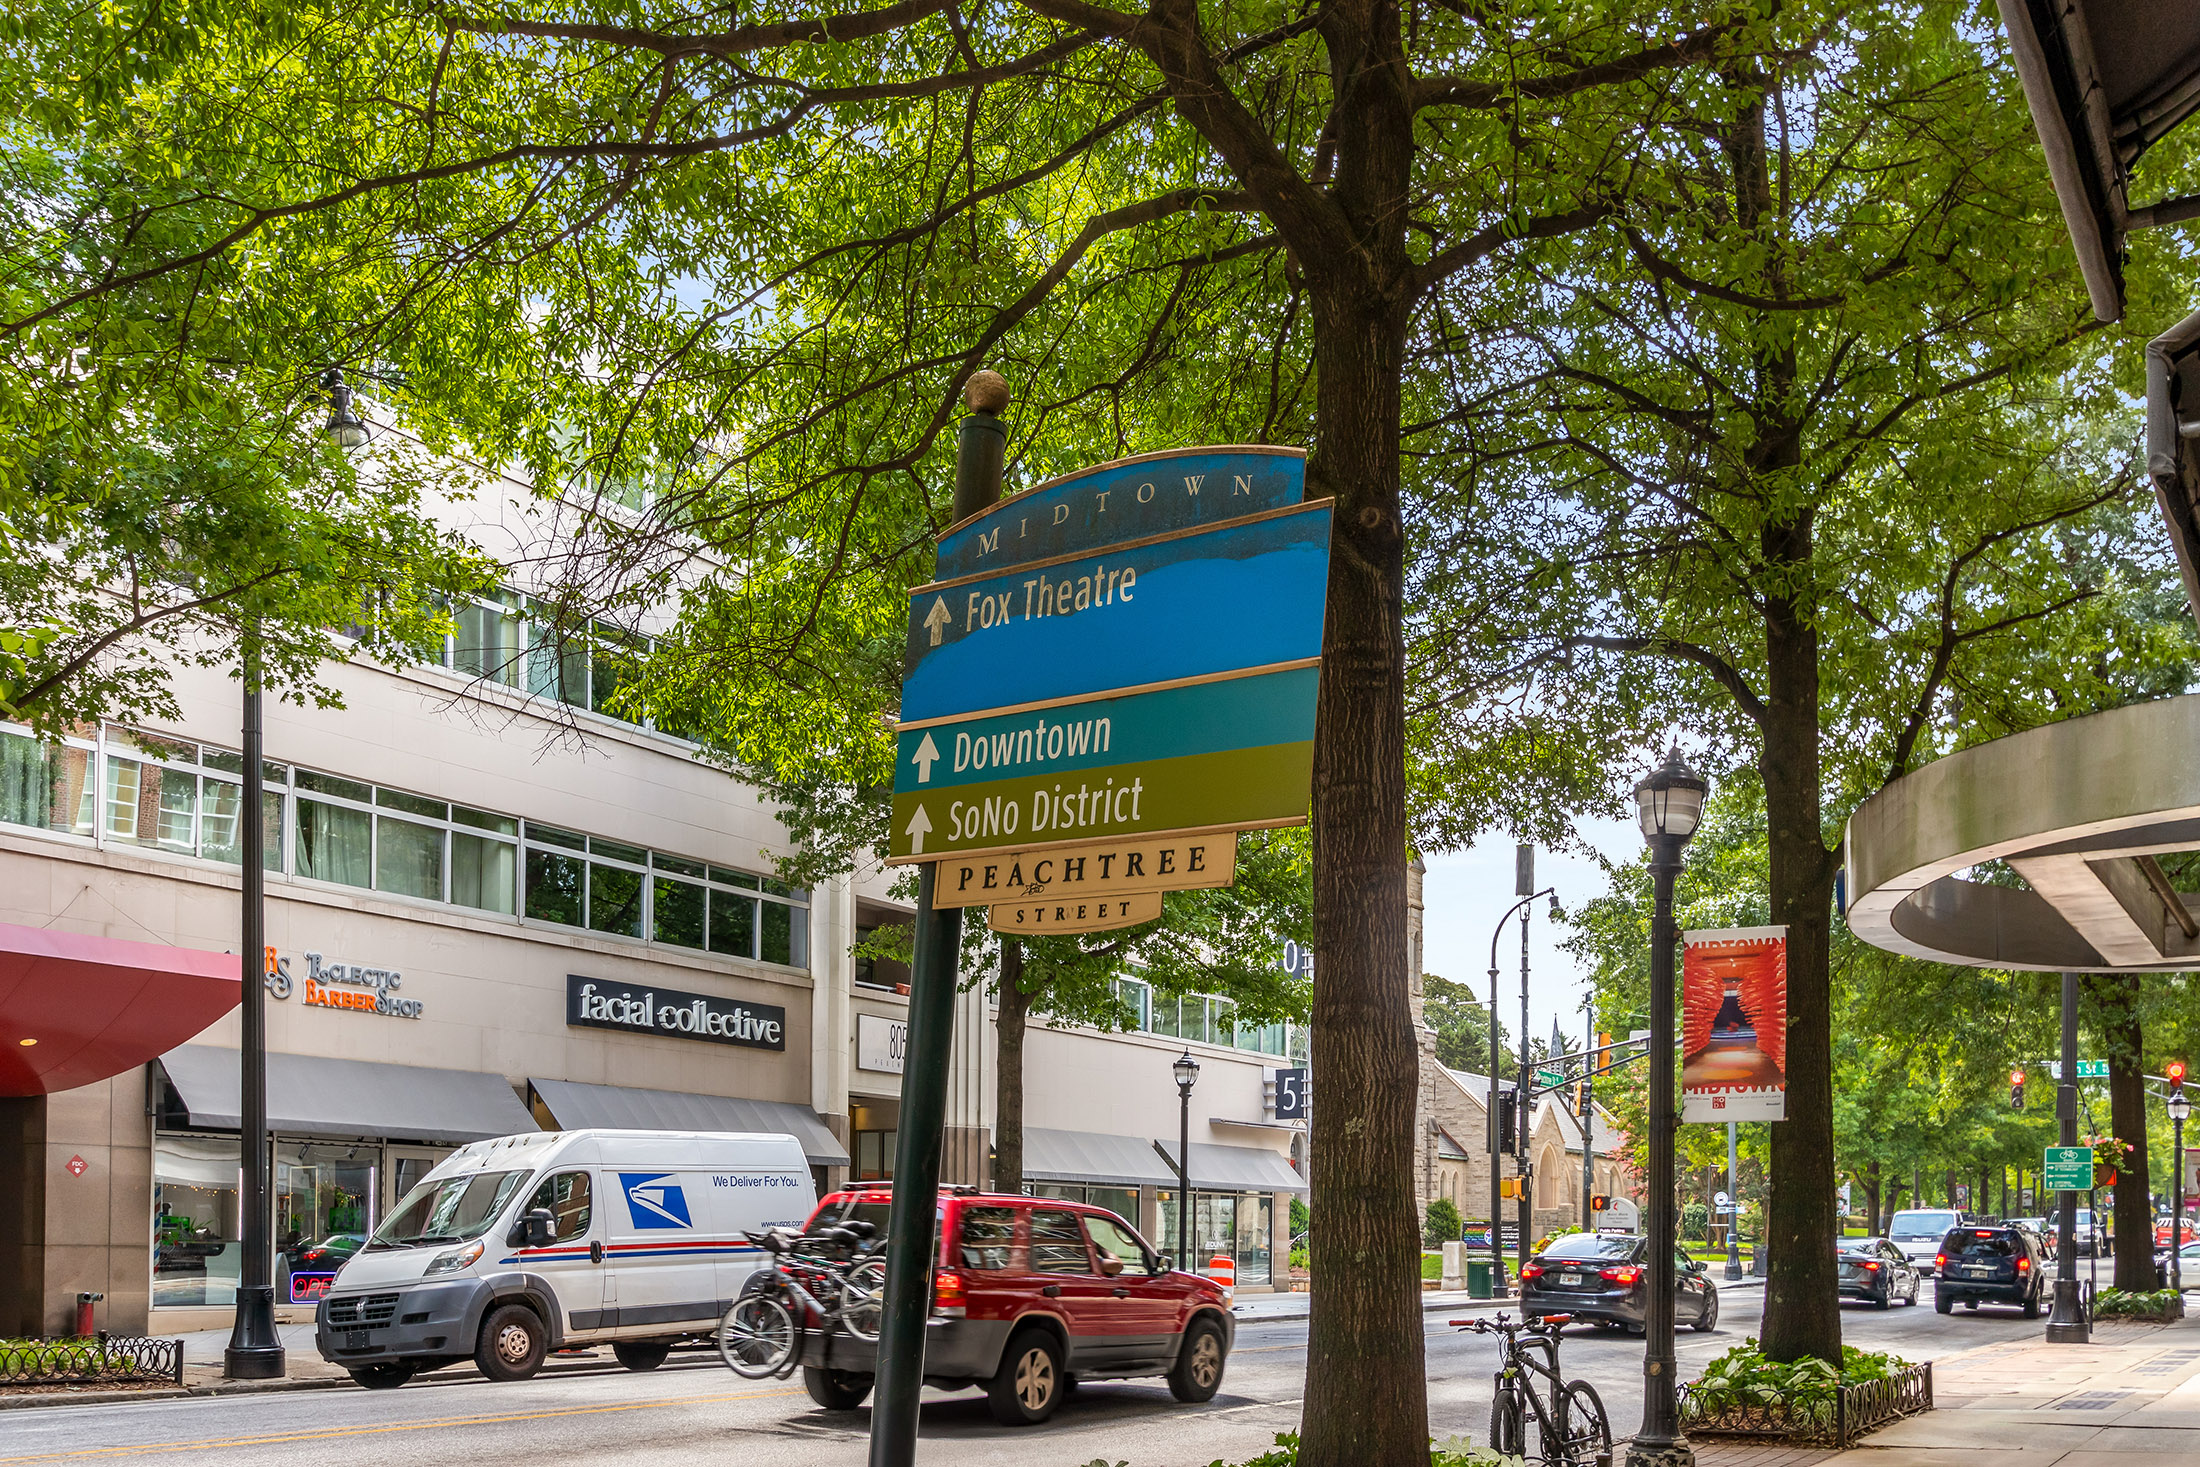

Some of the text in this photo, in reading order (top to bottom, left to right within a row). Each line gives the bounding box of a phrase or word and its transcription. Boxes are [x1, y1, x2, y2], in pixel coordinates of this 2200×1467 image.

[976, 474, 1253, 558] MIDTOWN
[966, 565, 1136, 632] Fox Theatre
[954, 717, 1111, 773] Downtown
[947, 777, 1143, 841] SoNo District
[958, 846, 1206, 891] PEACHTREE
[1016, 901, 1130, 923] STREET
[1283, 939, 1298, 973] 0
[580, 983, 781, 1044] facial collective
[1283, 1076, 1297, 1111] 5
[712, 1176, 799, 1187] We Deliver For You.
[292, 1277, 334, 1298] OPE
